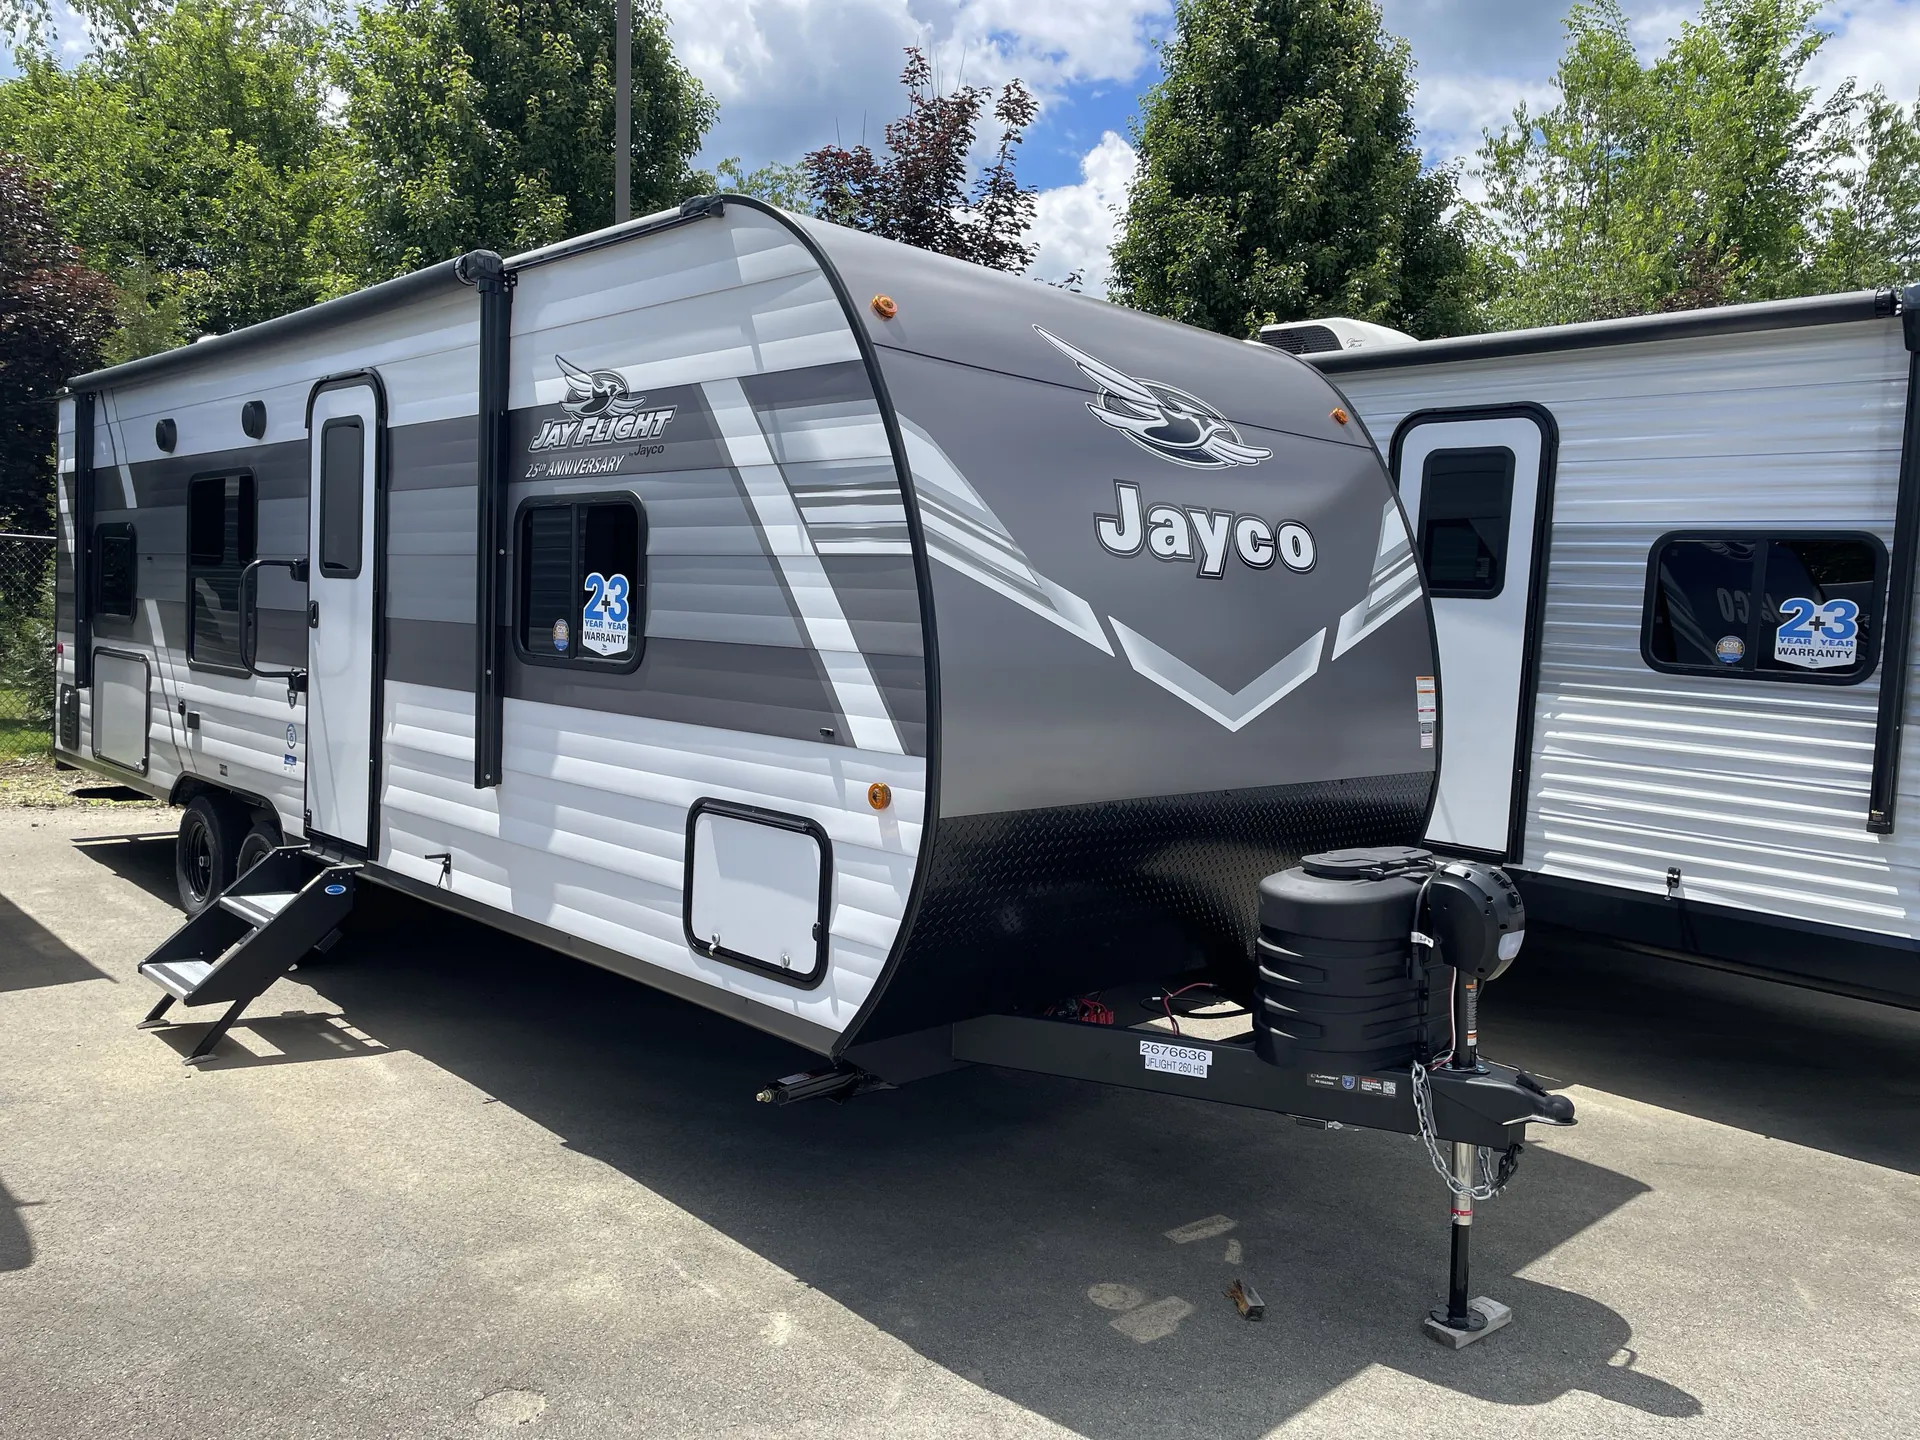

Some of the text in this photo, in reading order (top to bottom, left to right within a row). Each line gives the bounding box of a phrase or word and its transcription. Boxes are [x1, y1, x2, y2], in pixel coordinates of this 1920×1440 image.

[529, 405, 677, 453] JAY FLIGHT
[634, 444, 665, 457] Jayco
[525, 455, 625, 479] 25th ANNIVERSARY
[1093, 478, 1318, 580] Jayco
[585, 620, 604, 629] YEAR
[608, 622, 627, 631] YEAR
[584, 631, 627, 644] WARRANTY
[1779, 637, 1812, 645] YEAR
[1819, 639, 1854, 647] YEAR
[1777, 647, 1853, 659] WARRANTY
[1141, 1043, 1207, 1061] 2676636
[1145, 1057, 1205, 1075] JFLIGHT 260 HB
